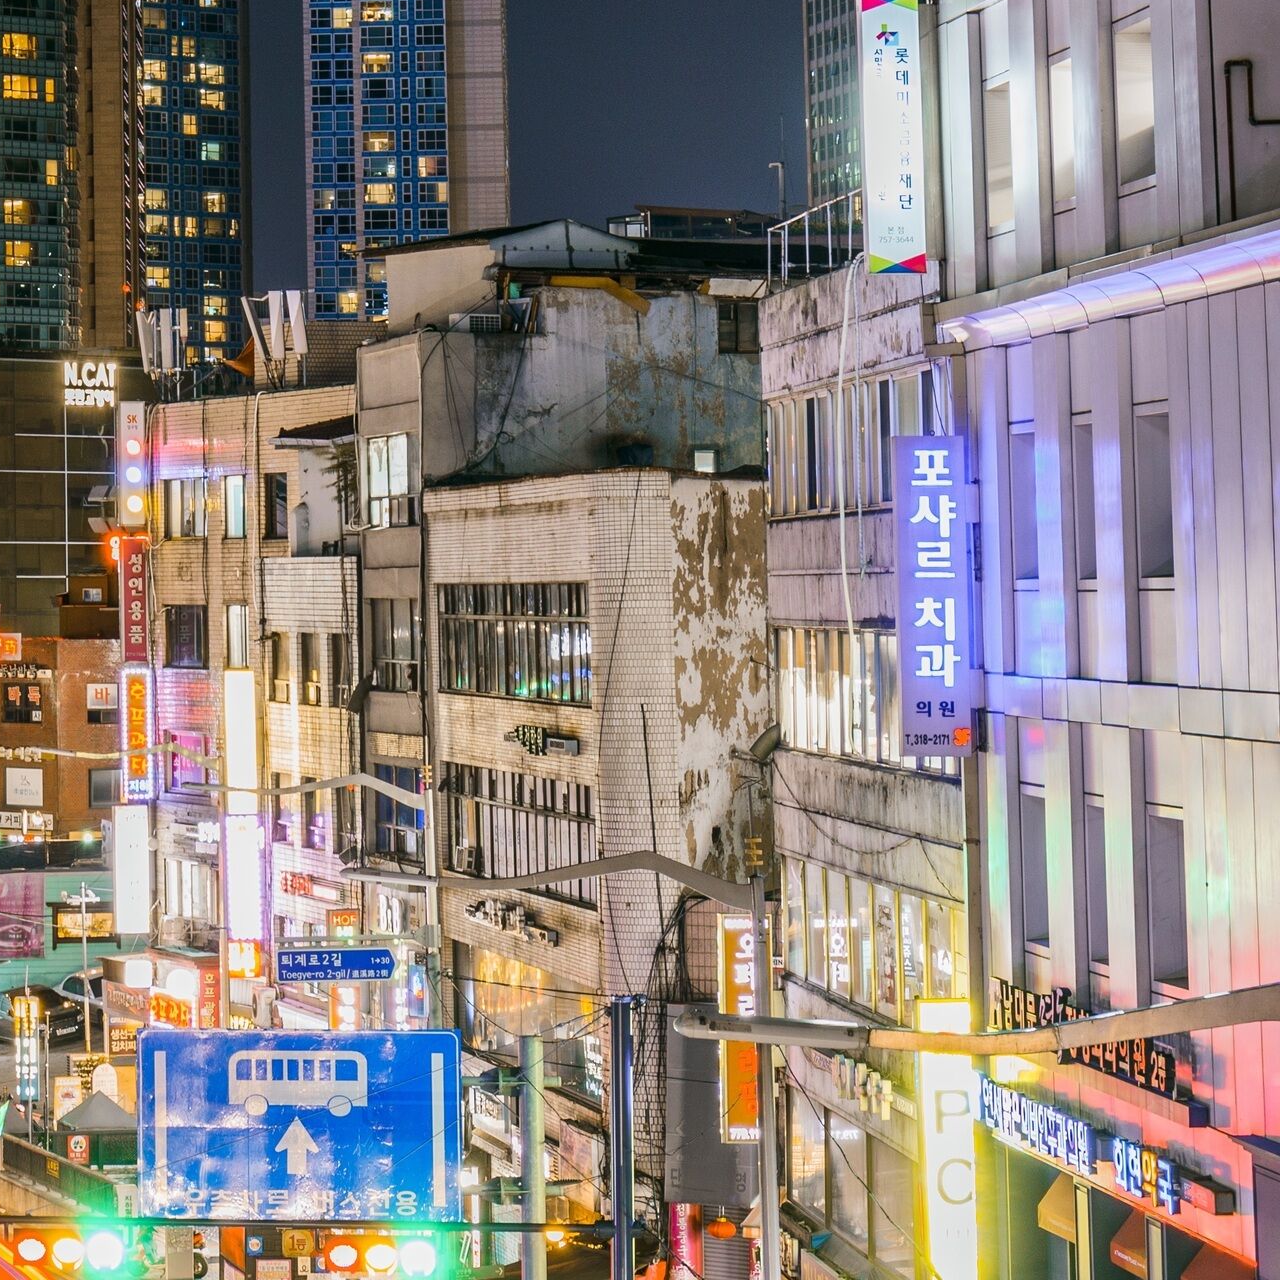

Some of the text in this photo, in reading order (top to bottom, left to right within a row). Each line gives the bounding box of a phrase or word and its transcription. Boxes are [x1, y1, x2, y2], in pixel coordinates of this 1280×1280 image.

[64, 362, 116, 387] N.CAT
[127, 414, 138, 424] SK
[910, 448, 961, 689] 포샤르 치과
[127, 553, 145, 645] 성인용품
[915, 699, 957, 718] 의원
[905, 732, 951, 747] T.318-2171
[332, 914, 357, 926] HOF
[281, 952, 342, 967] 퇴계로2길
[281, 969, 325, 981] Toegye-ro
[1113, 1136, 1180, 1216] 회현약국
[289, 1234, 307, 1252] 1등
